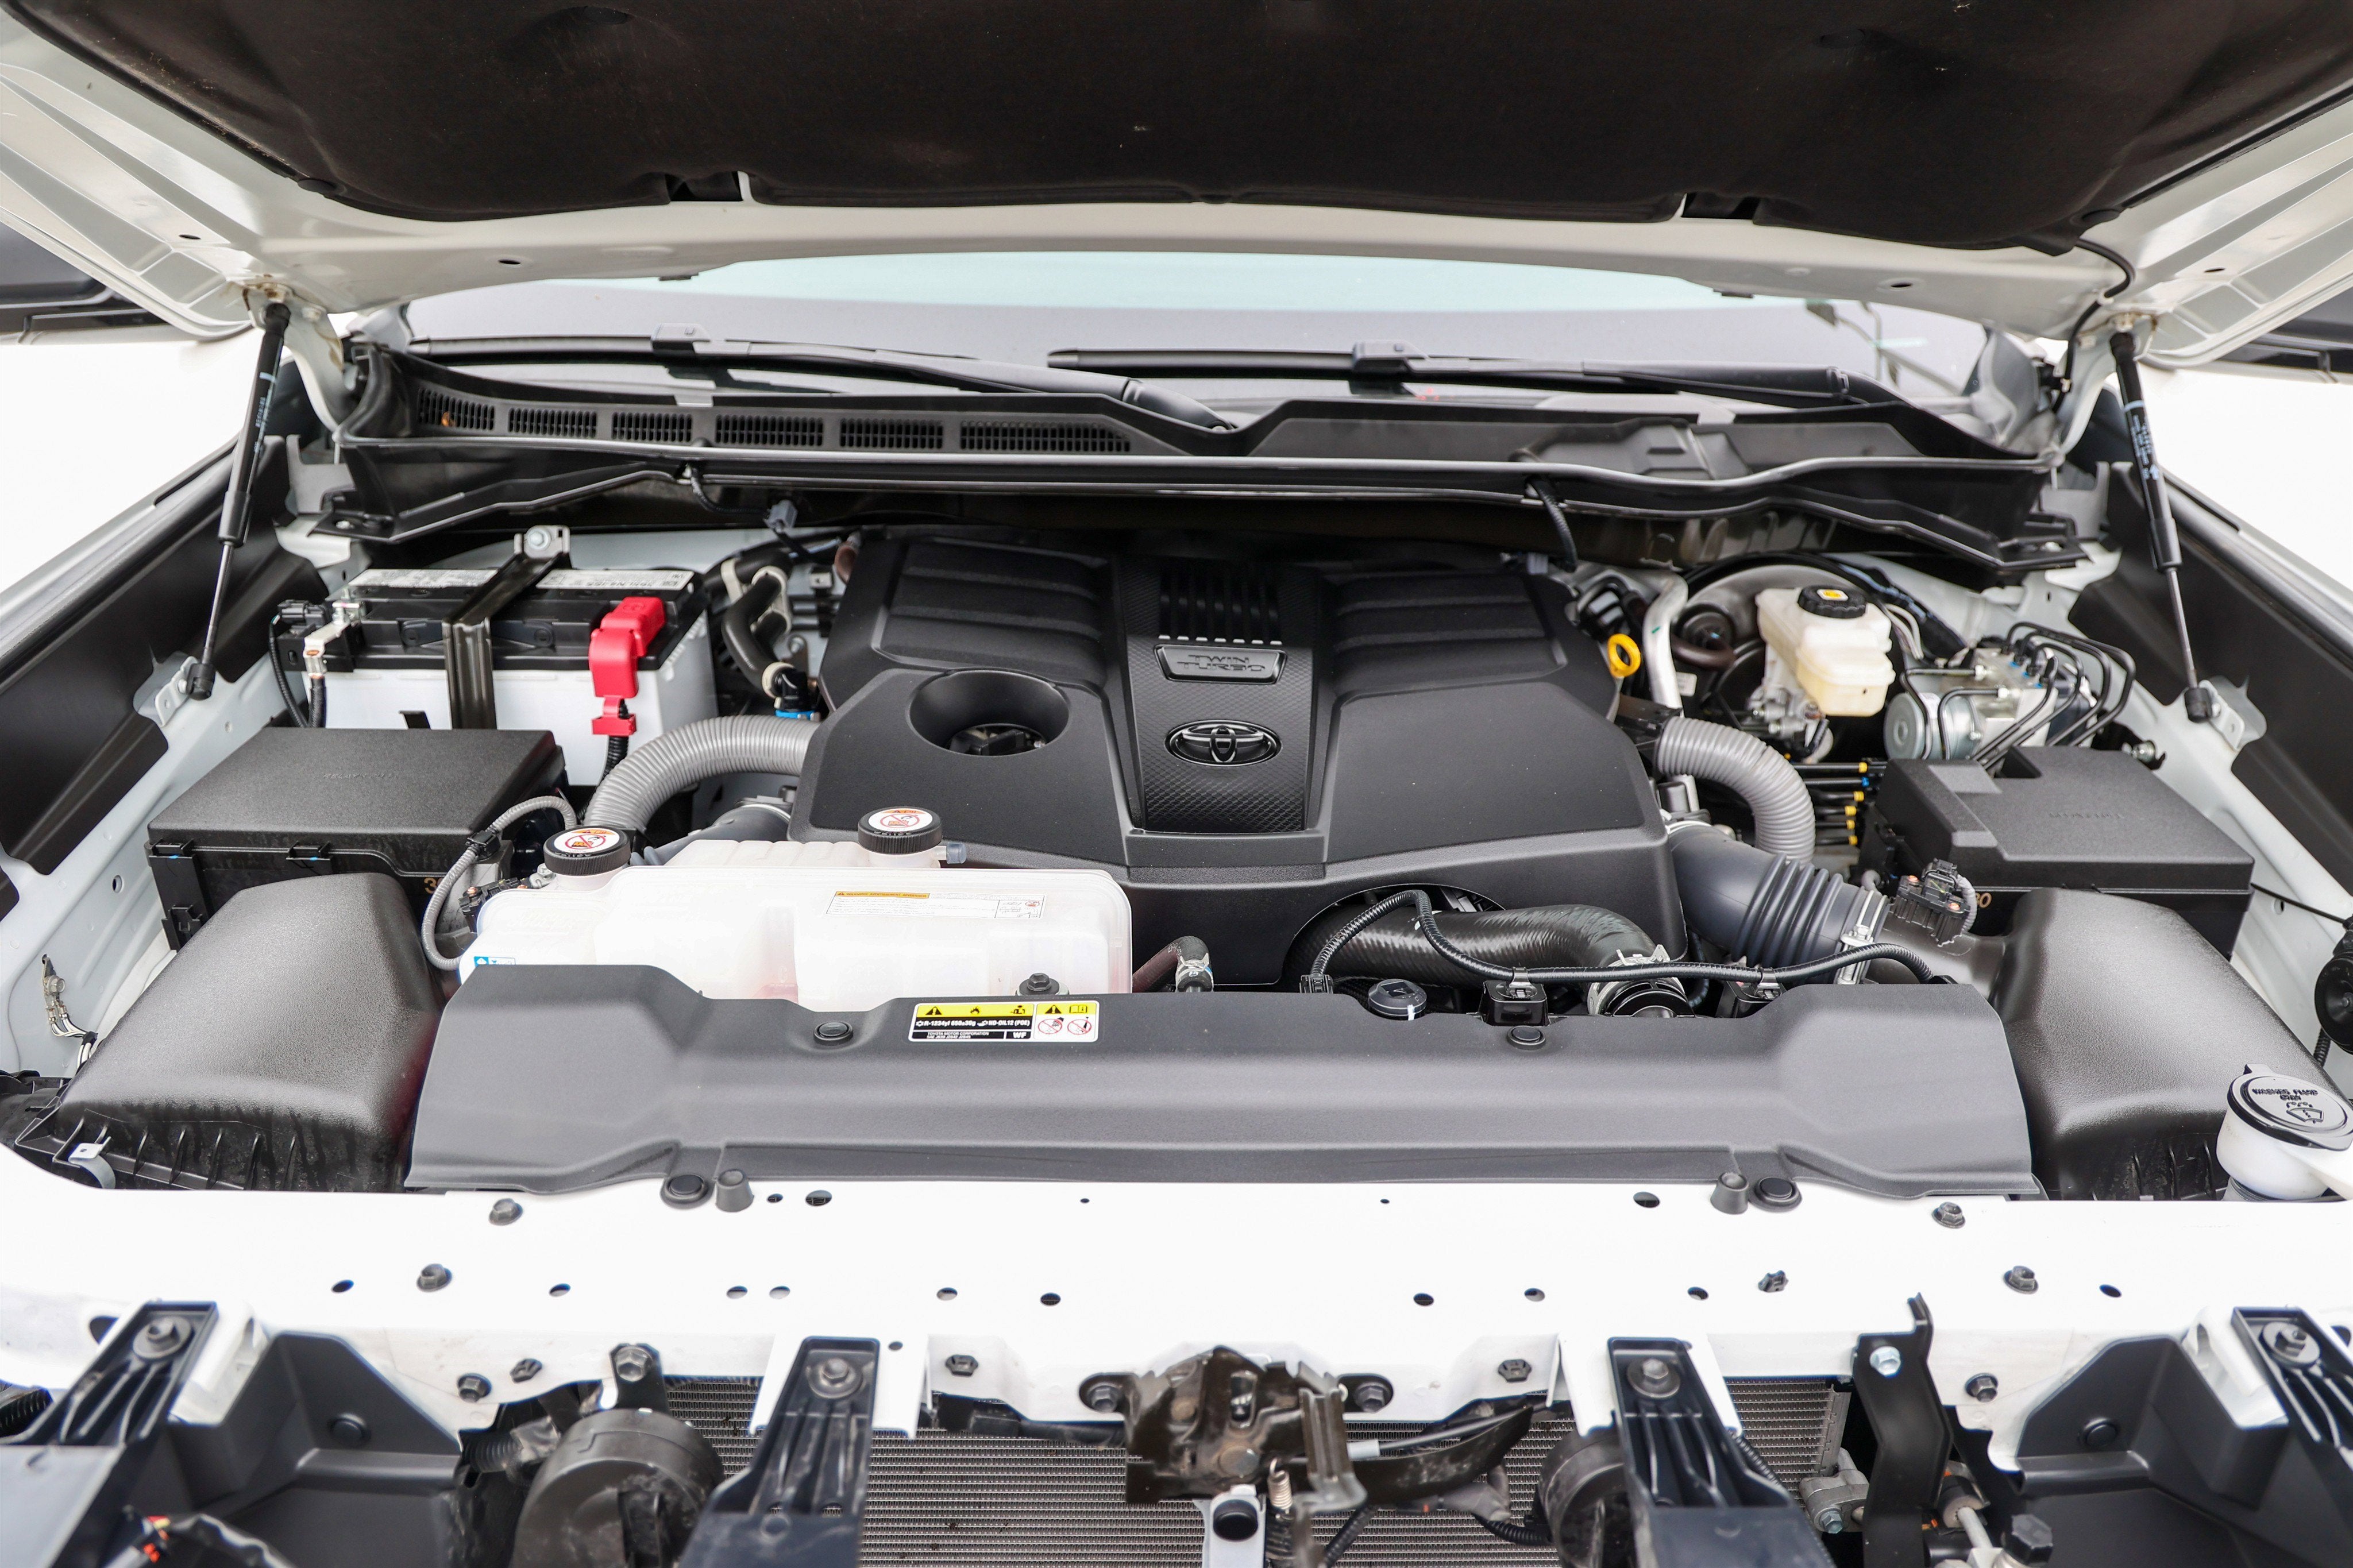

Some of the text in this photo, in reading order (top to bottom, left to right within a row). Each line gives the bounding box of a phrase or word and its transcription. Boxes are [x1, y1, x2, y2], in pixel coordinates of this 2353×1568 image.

[1188, 655, 1249, 663] TWIN
[1177, 662, 1266, 671] TURBO
[423, 877, 443, 894] 3
